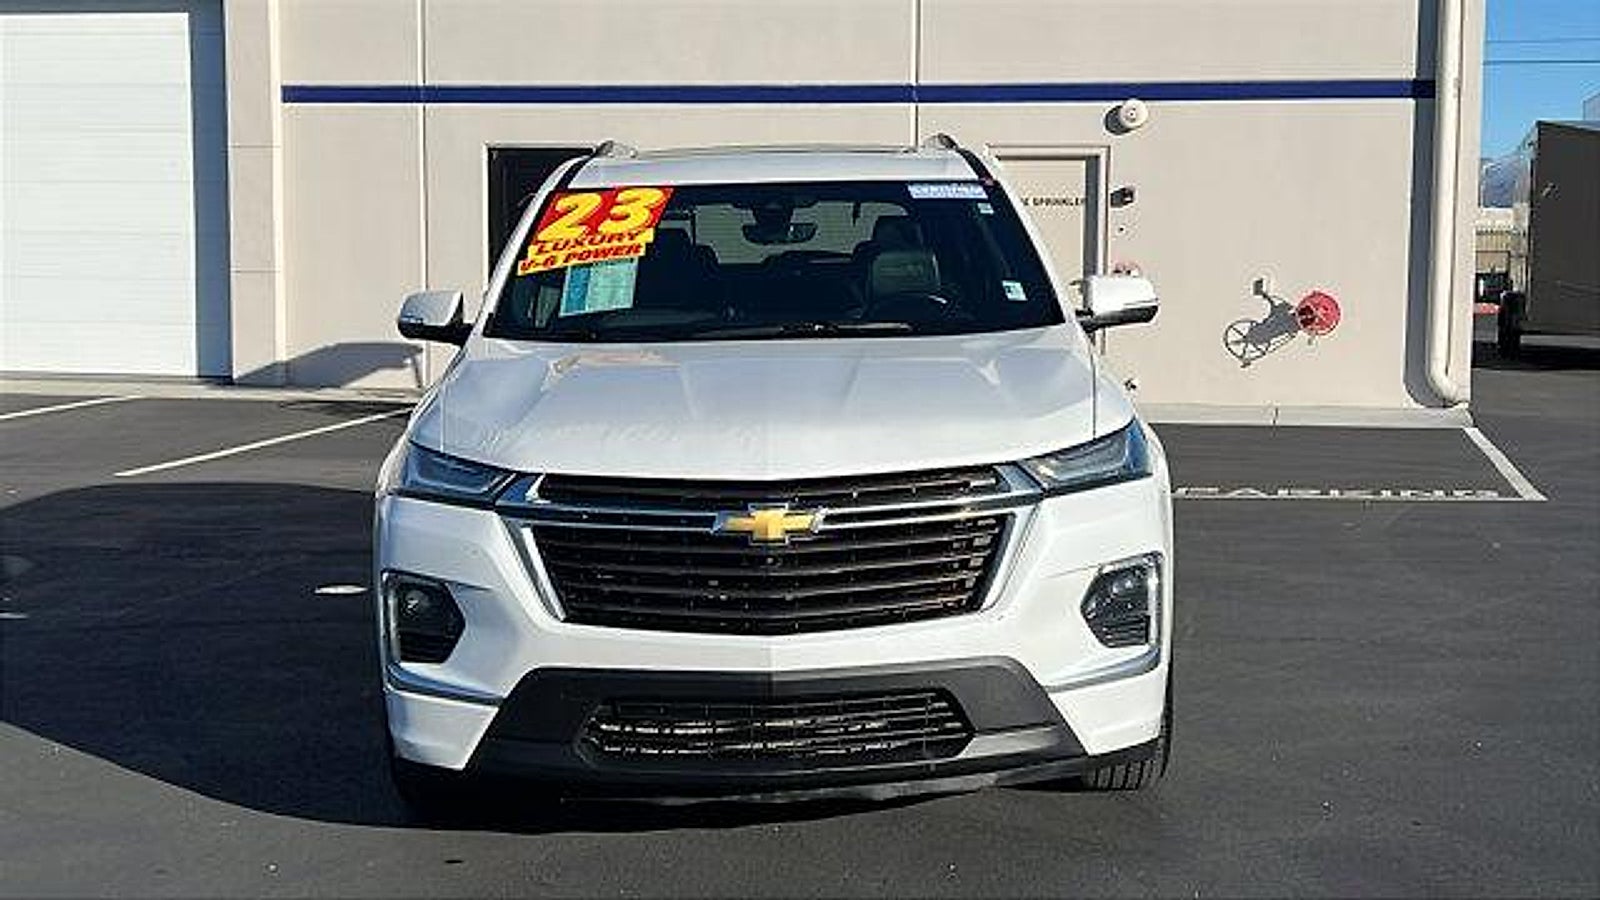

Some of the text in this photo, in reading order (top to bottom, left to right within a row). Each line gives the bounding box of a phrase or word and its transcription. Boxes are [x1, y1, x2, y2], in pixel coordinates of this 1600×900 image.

[538, 187, 664, 241] 23
[537, 230, 641, 253] LUXURY
[520, 243, 643, 271] V-6 POWER
